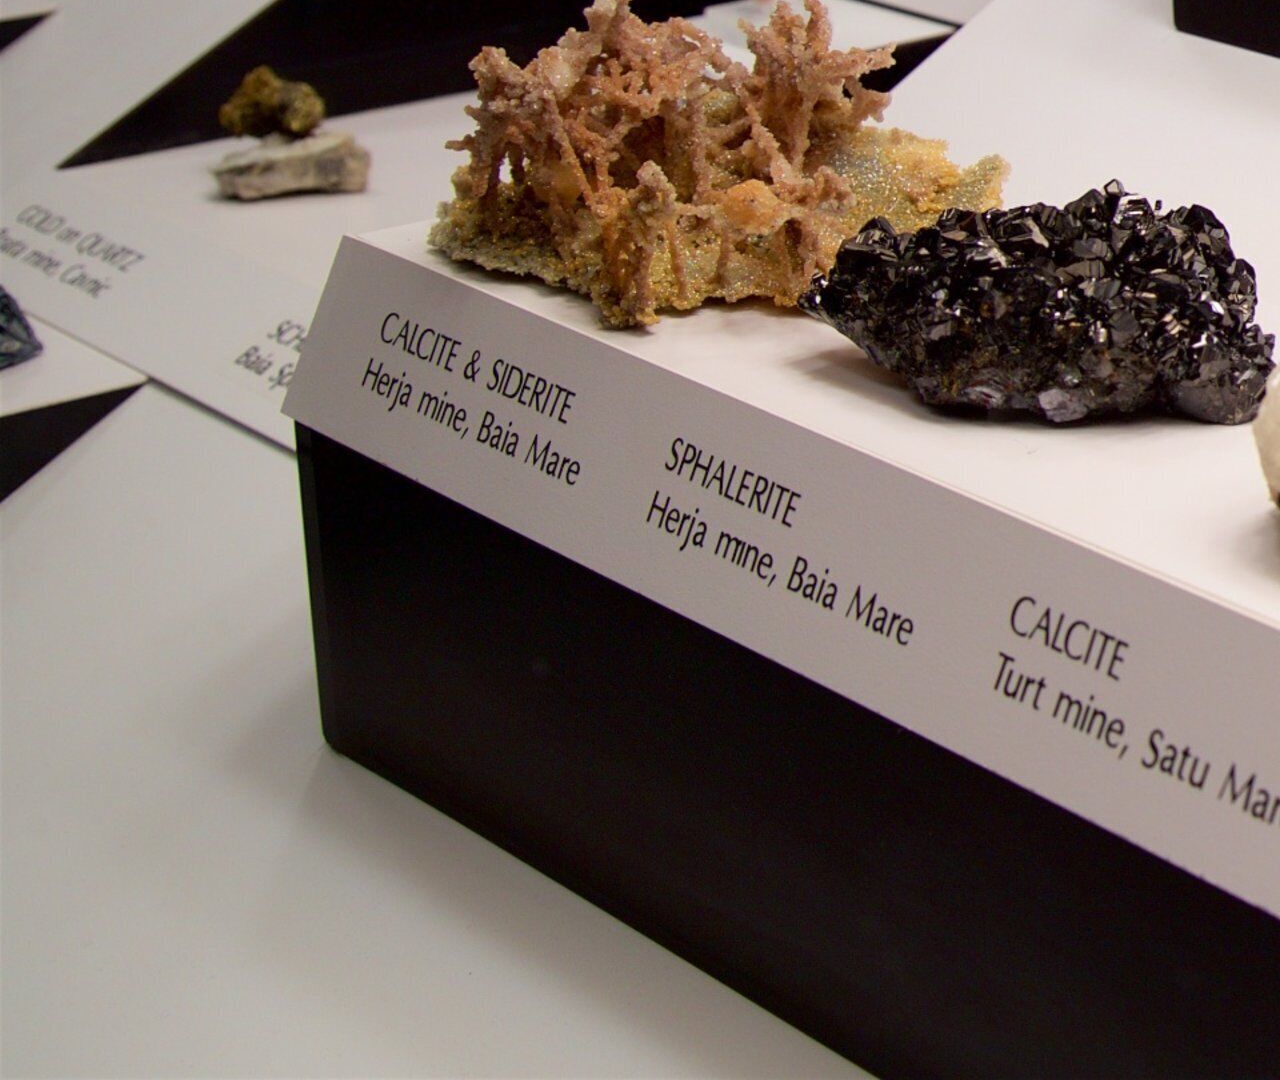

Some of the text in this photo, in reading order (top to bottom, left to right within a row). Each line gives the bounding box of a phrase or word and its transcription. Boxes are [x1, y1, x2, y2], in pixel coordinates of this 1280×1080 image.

[360, 357, 581, 486] Herja mine, Baia Mare
[380, 311, 577, 425] CALCITE & SIDERITE
[664, 437, 803, 529] SPHALERITE
[645, 489, 914, 647] Herja mine, Baia Mare
[1009, 595, 1130, 682] CALCITE
[993, 651, 1047, 711] Turt
[1052, 690, 1129, 759] mine,
[1140, 728, 1211, 791] Satu
